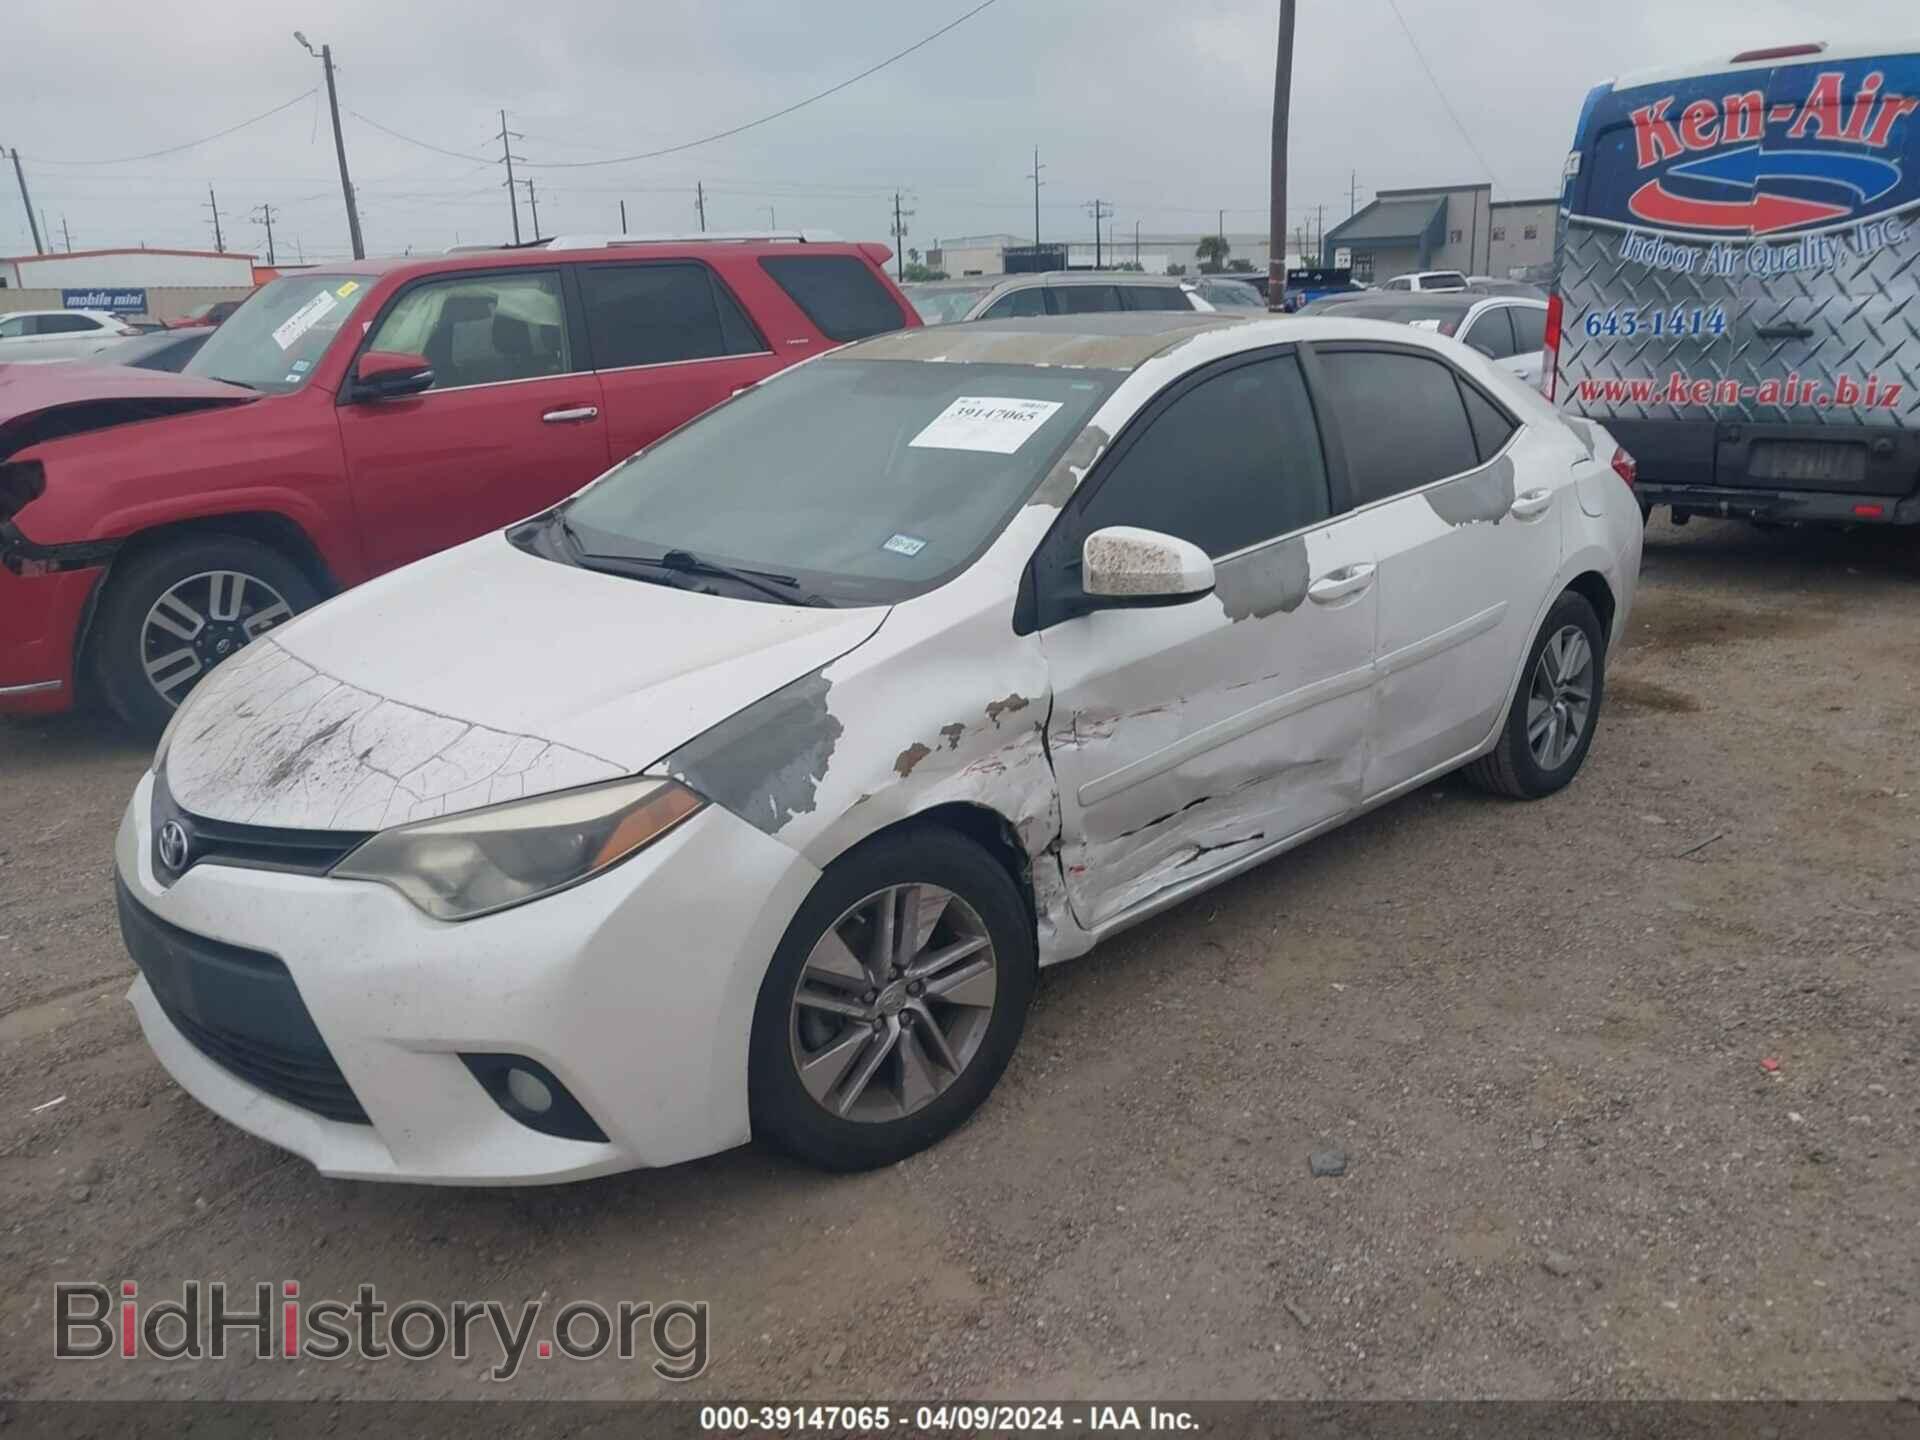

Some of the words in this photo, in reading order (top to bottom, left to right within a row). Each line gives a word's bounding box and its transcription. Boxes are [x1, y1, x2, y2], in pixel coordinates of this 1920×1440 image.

[1631, 71, 1919, 169] Ken-Air
[1620, 230, 1701, 271] Indoor
[1701, 240, 1740, 276] Air
[1745, 231, 1849, 279] Quality,
[1854, 214, 1911, 252] Inc.
[66, 292, 113, 306] mobile
[113, 294, 143, 305] mini
[1584, 307, 1728, 338] 643-1414
[1578, 371, 1904, 409] www.ken-air.biz
